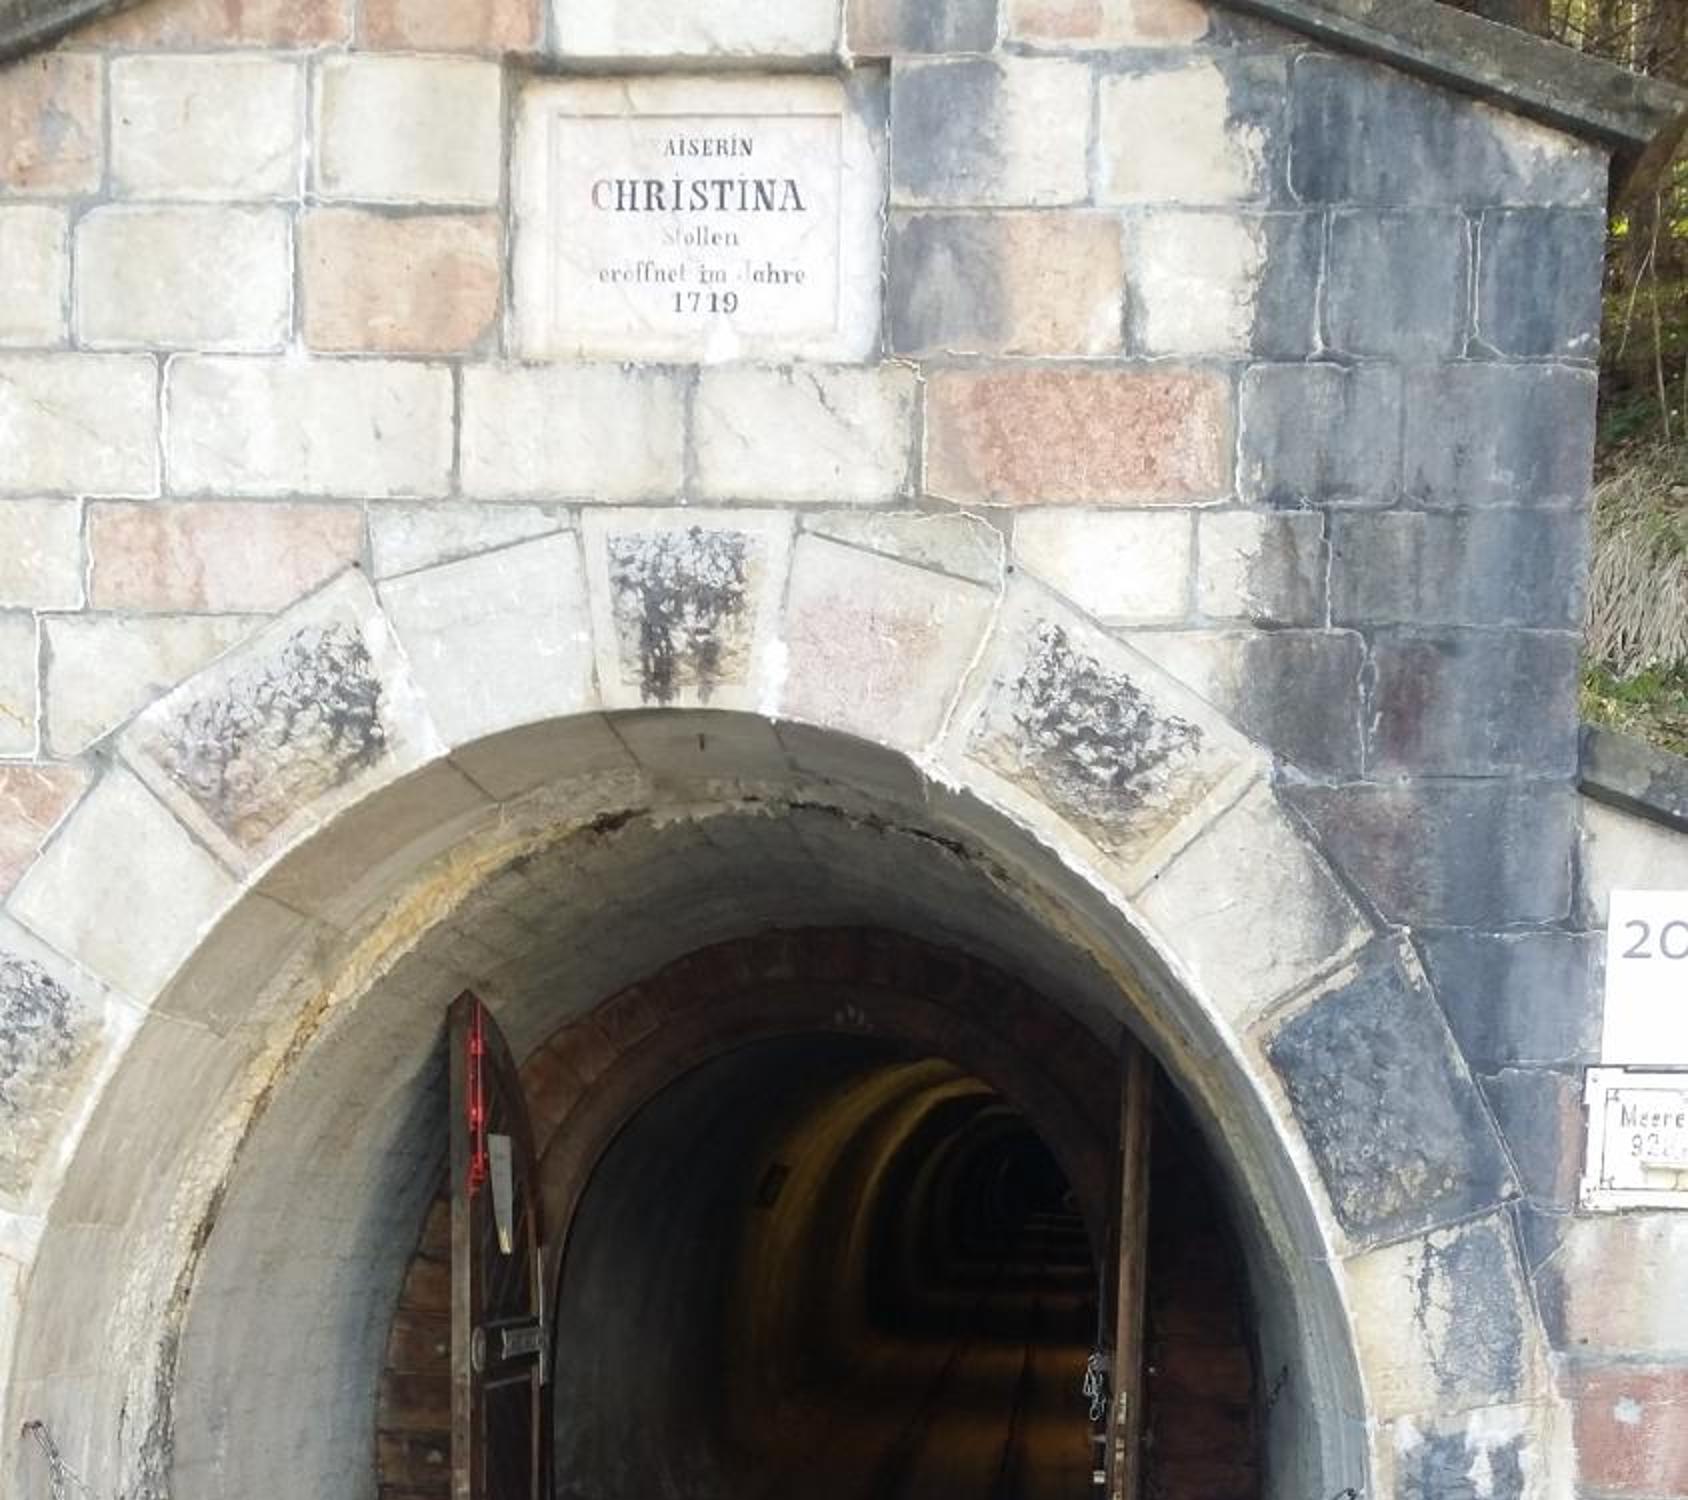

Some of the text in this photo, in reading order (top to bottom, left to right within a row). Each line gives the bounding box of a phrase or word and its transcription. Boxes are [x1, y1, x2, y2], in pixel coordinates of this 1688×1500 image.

[654, 133, 754, 157] AISERIN
[591, 173, 807, 212] CHRISTINA
[698, 264, 728, 284] im
[673, 291, 739, 314] 1719
